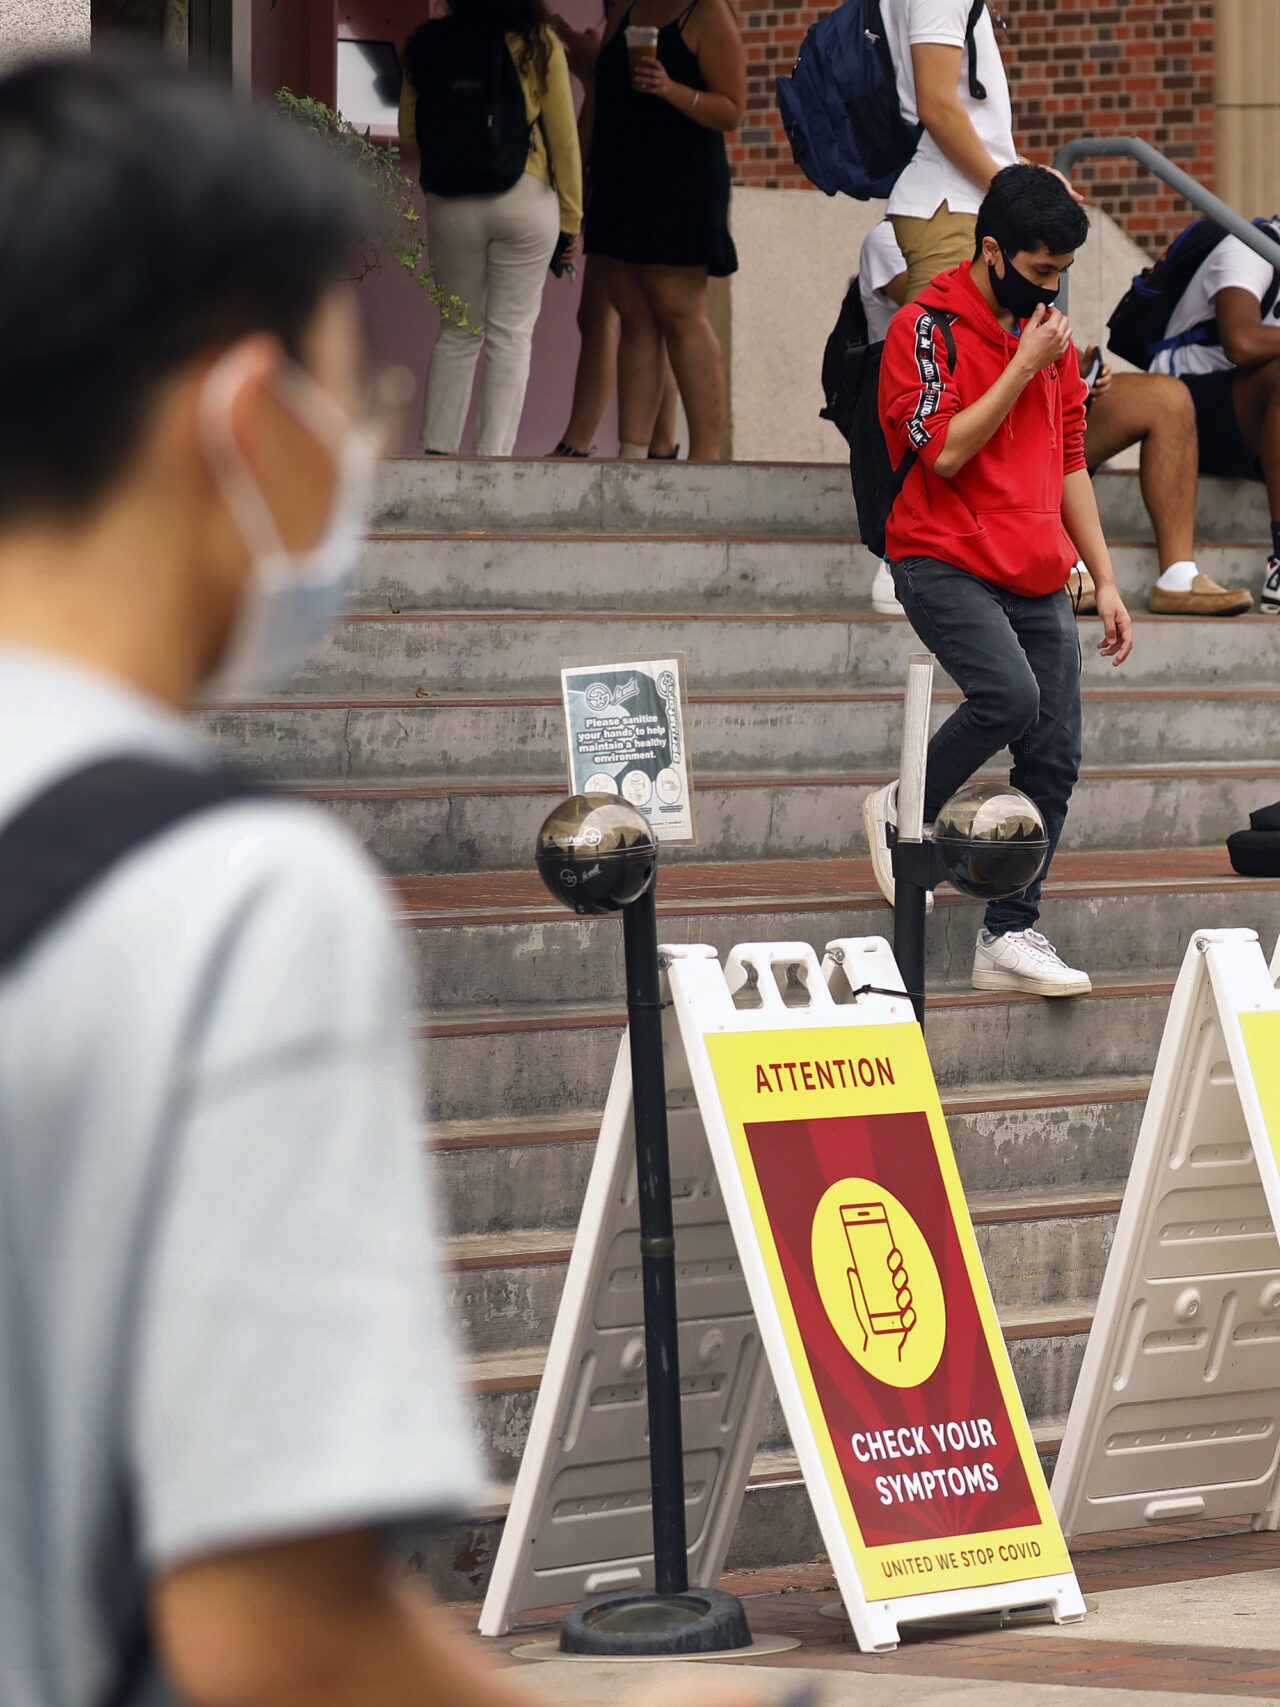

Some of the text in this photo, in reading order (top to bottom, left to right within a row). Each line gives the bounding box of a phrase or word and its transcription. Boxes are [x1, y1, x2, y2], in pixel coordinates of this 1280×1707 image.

[577, 726, 666, 743] your hands to help
[585, 715, 658, 728] Please sanitize
[579, 738, 666, 752] maintain a healthy
[594, 750, 656, 763] environment.
[756, 1057, 895, 1093] ATTENTION
[851, 1418, 997, 1463] CHECK YOUR
[875, 1462, 1000, 1506] SYMPTOMS
[881, 1541, 1041, 1578] UNITED WE STOP COVID
